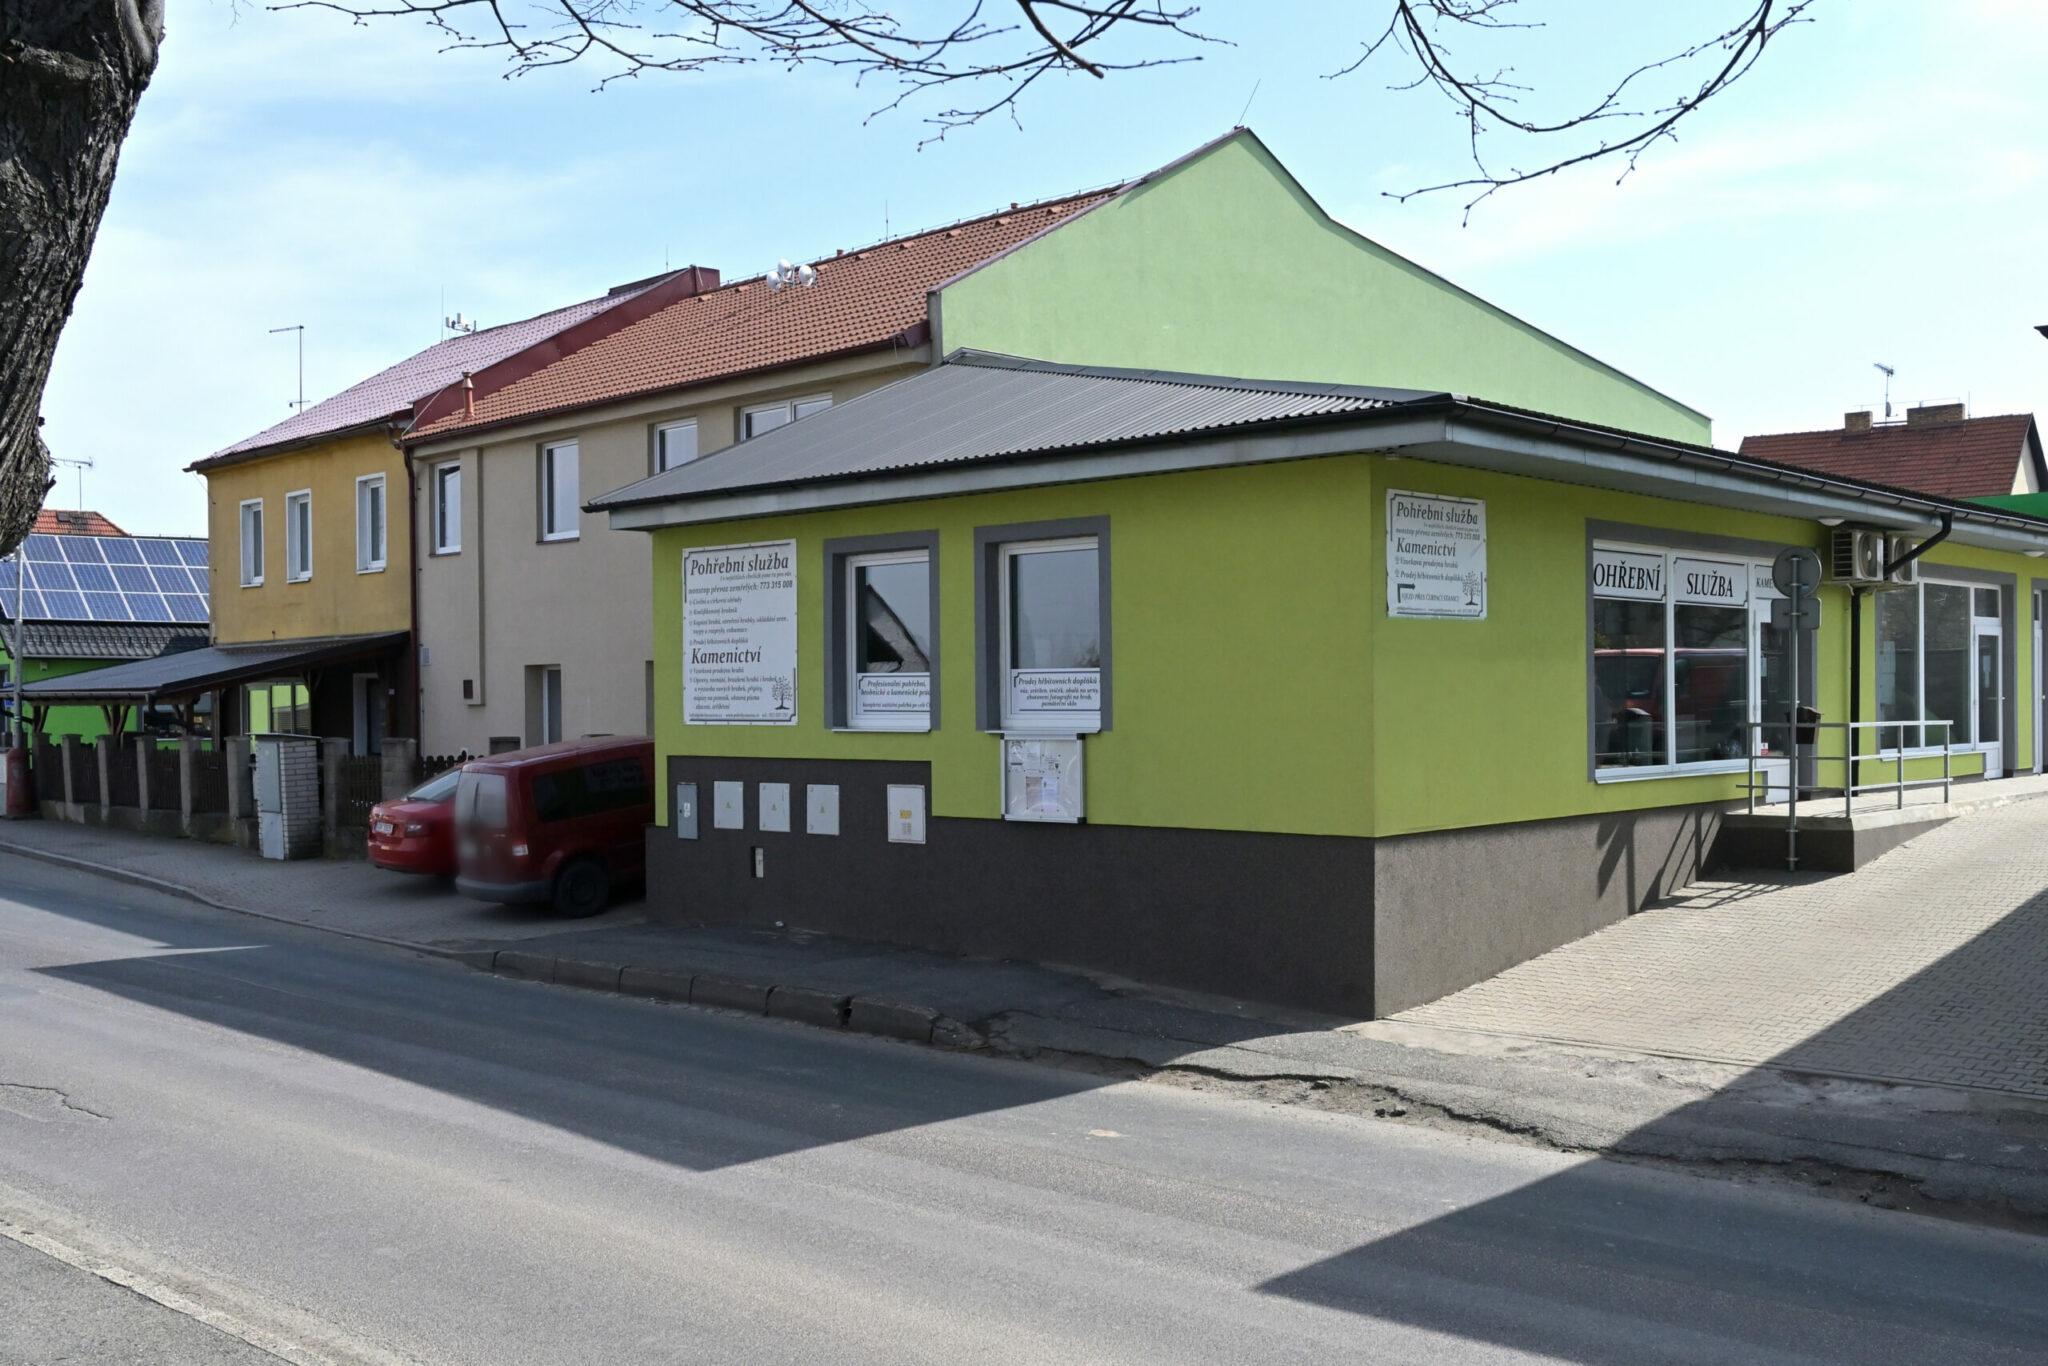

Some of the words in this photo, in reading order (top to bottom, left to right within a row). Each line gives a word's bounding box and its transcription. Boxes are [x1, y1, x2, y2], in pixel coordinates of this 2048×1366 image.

[1446, 506, 1479, 525] služba
[1396, 537, 1457, 557] Kamenictví
[690, 555, 746, 576] Pohřební
[747, 552, 790, 573] služba
[760, 581, 770, 590] 773
[771, 581, 781, 589] 315
[1593, 560, 1662, 592] OHŘEBNÍ
[1686, 570, 1734, 598] SLUŽBA
[1756, 577, 1774, 589] KAME
[691, 646, 762, 664] Kamenictví
